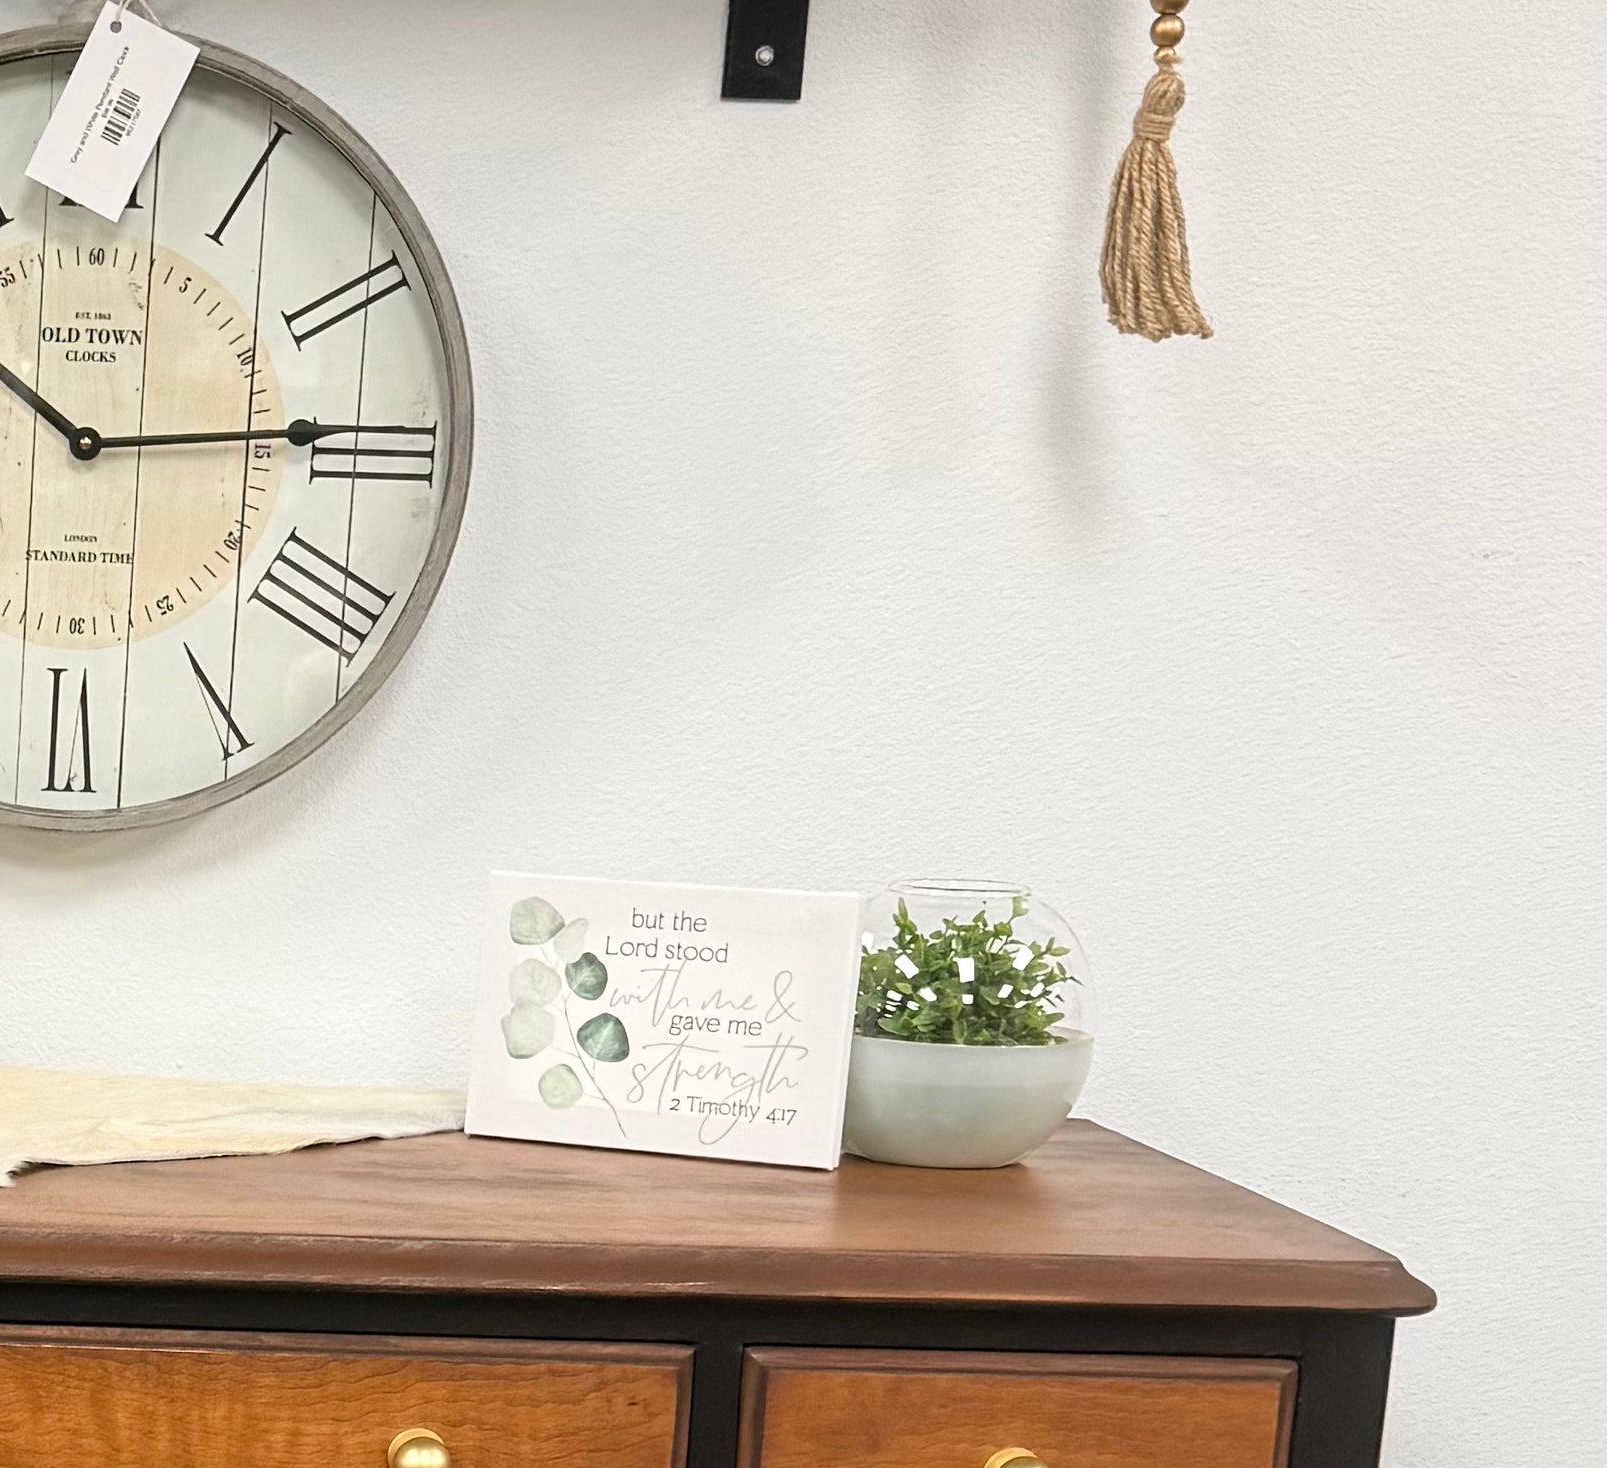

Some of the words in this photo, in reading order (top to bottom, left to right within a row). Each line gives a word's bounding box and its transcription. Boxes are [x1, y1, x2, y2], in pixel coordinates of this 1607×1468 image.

[89, 248, 105, 266] 60
[179, 277, 192, 293] 5
[42, 327, 80, 343] OLD
[85, 328, 144, 346] TOWN
[65, 349, 117, 363] CLOCKS
[236, 347, 254, 366] 10
[254, 442, 271, 460] 15
[223, 530, 243, 551] 20
[25, 549, 97, 563] STANDARD
[100, 552, 133, 564] TIME
[156, 594, 175, 616] 25
[69, 617, 85, 635] 30
[631, 907, 665, 930] but
[672, 910, 708, 933] the
[604, 935, 658, 958] Lord
[664, 940, 729, 963] stood
[609, 958, 690, 1027] with
[701, 990, 757, 1012] me
[764, 970, 802, 1023] &
[667, 1014, 722, 1036] gave
[726, 1018, 763, 1037] me
[626, 1032, 809, 1146] strength
[668, 1098, 681, 1113] 2
[686, 1095, 761, 1124] Timothy
